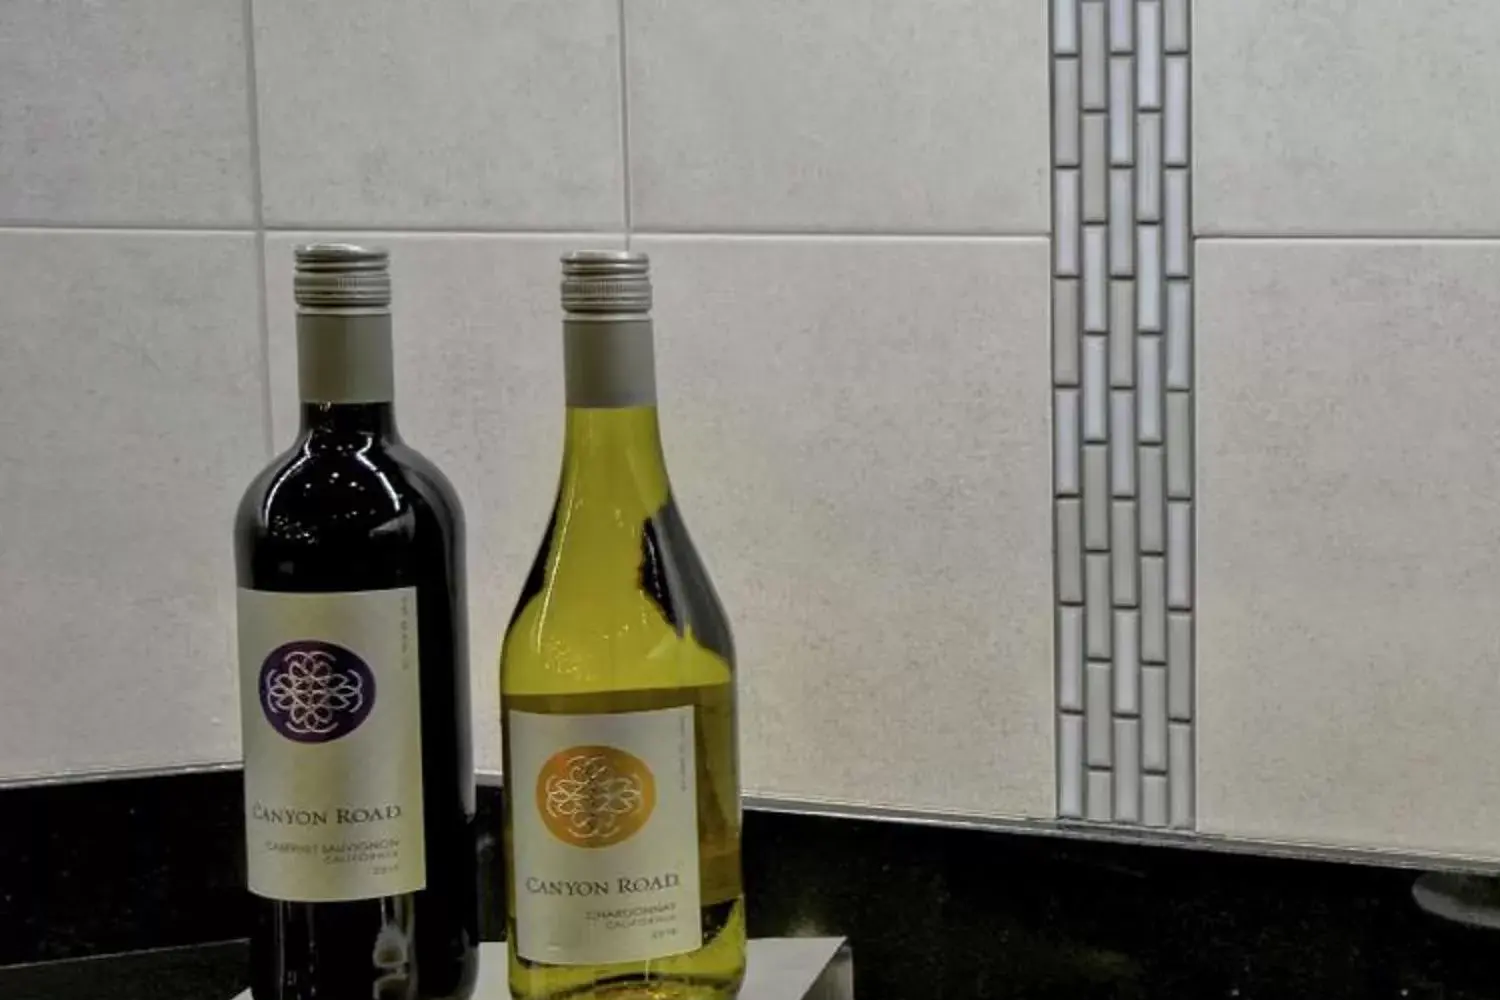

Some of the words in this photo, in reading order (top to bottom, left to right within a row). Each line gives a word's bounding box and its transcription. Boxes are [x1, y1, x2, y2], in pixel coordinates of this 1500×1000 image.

[253, 801, 328, 825] CANYON
[336, 805, 402, 824] ROAD
[525, 876, 609, 897] CANYON
[617, 873, 680, 894] ROAD
